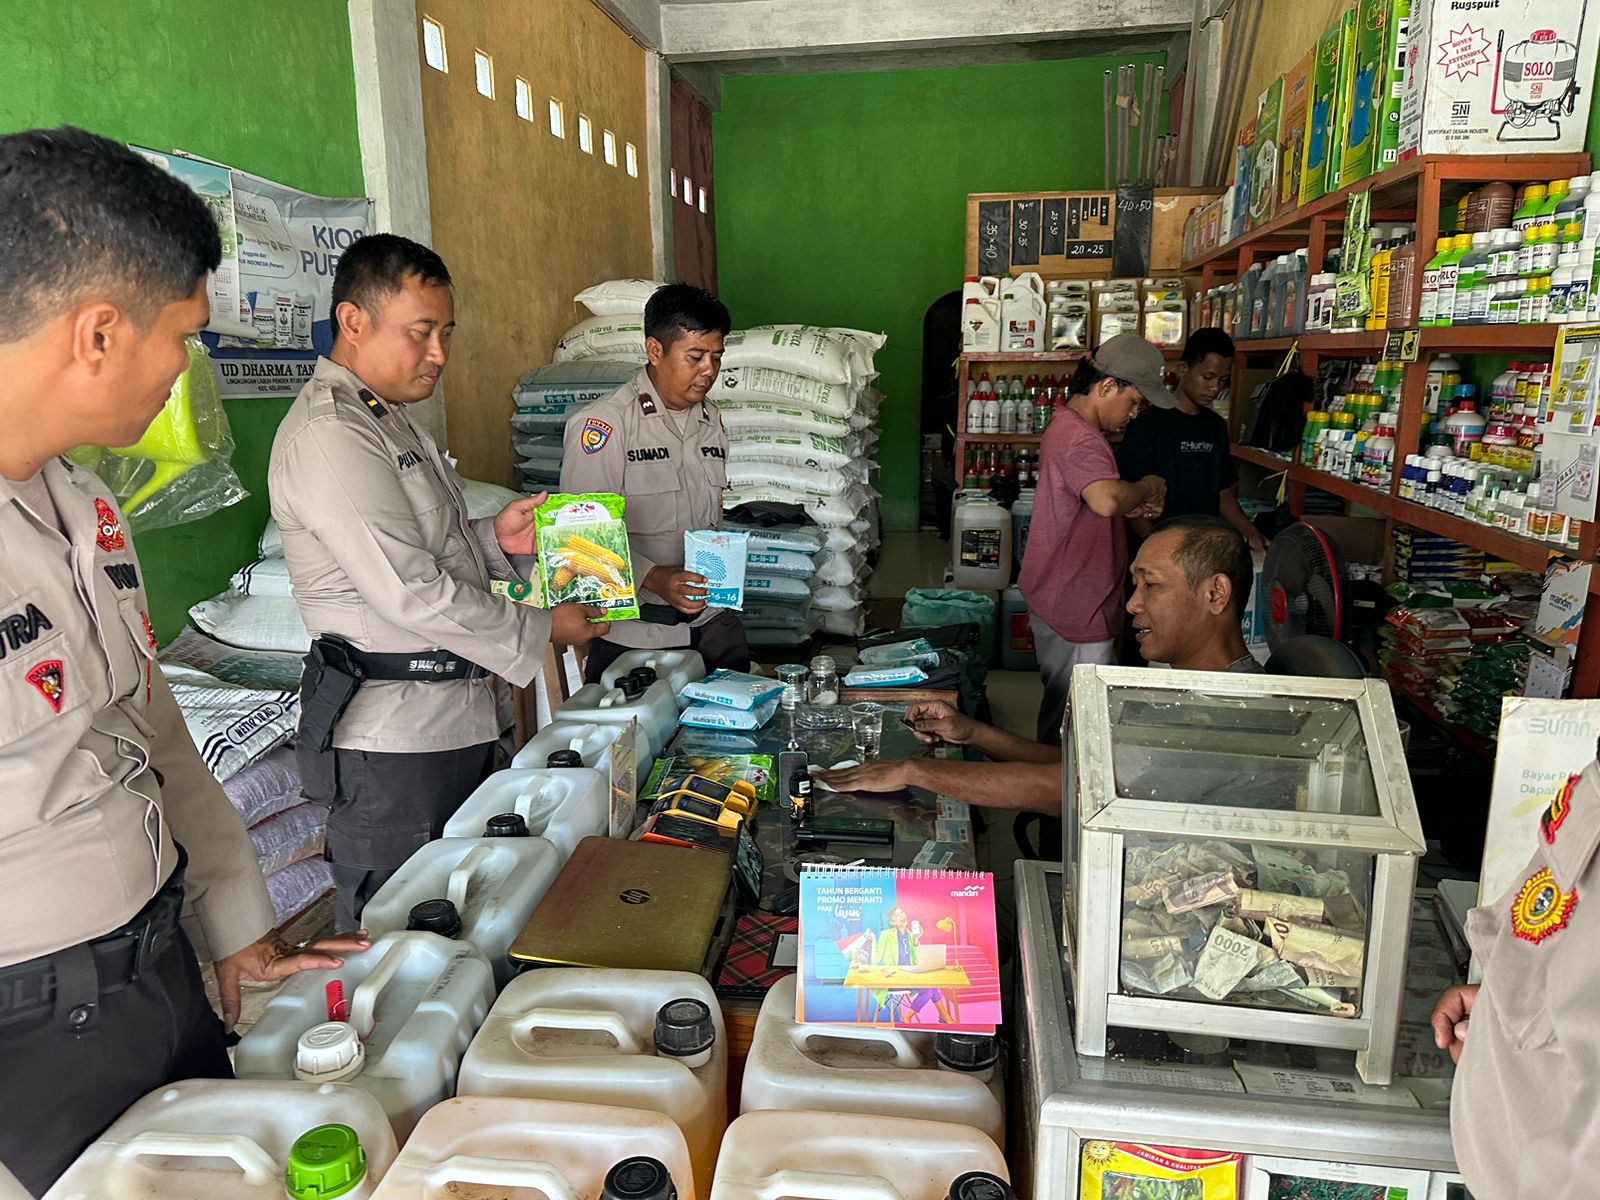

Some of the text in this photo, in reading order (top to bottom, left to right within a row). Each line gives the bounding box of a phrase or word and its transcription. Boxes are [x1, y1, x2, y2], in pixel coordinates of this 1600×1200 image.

[1451, 0, 1500, 11] Rugspuit
[1523, 61, 1554, 77] SOLO
[1451, 103, 1471, 116] SNI
[220, 363, 239, 377] UD
[241, 363, 294, 377] DHARMA
[627, 447, 670, 462] SUMADI
[1522, 768, 1557, 783] Bayar
[816, 887, 882, 895] TAHUN BERGANTI
[816, 895, 883, 904] PROMO MENANTI
[1213, 934, 1251, 957] 2000
[1136, 1149, 1165, 1164] JAMINAN
